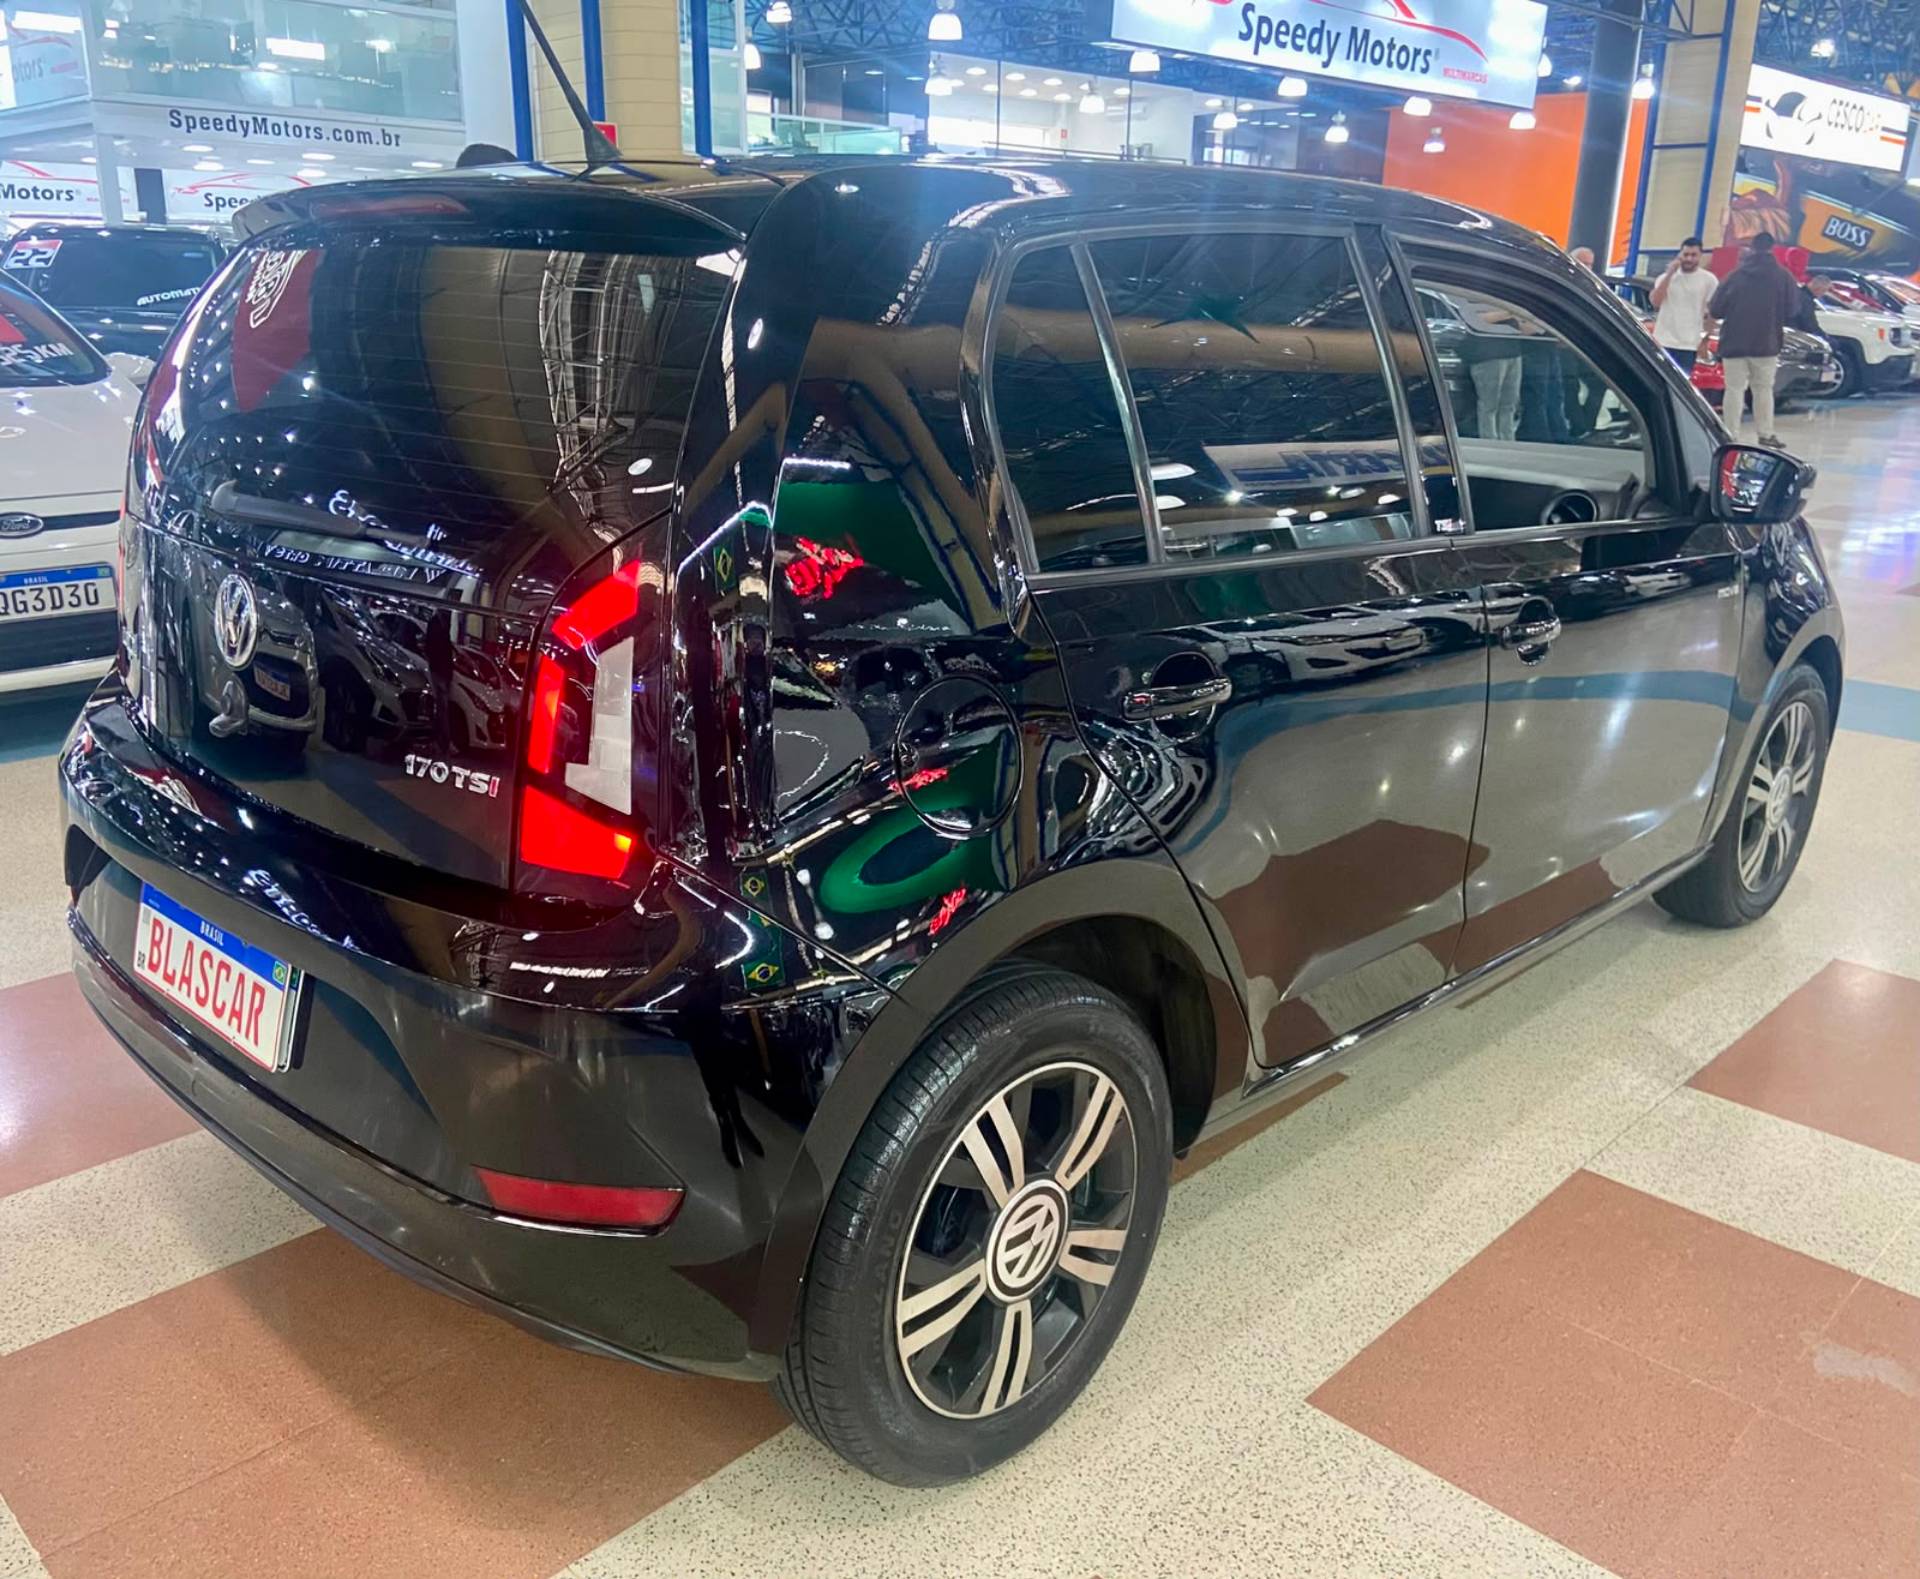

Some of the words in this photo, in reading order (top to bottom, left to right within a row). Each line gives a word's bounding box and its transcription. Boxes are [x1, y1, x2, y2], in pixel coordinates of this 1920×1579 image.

[1238, 2, 1341, 69] Speedy
[1346, 26, 1433, 74] Motors
[169, 109, 400, 147] SpeedyMotors.com.br
[1824, 216, 1871, 247] BOSS
[200, 920, 225, 947] BRASIL
[148, 917, 266, 1048] BLASCAR
